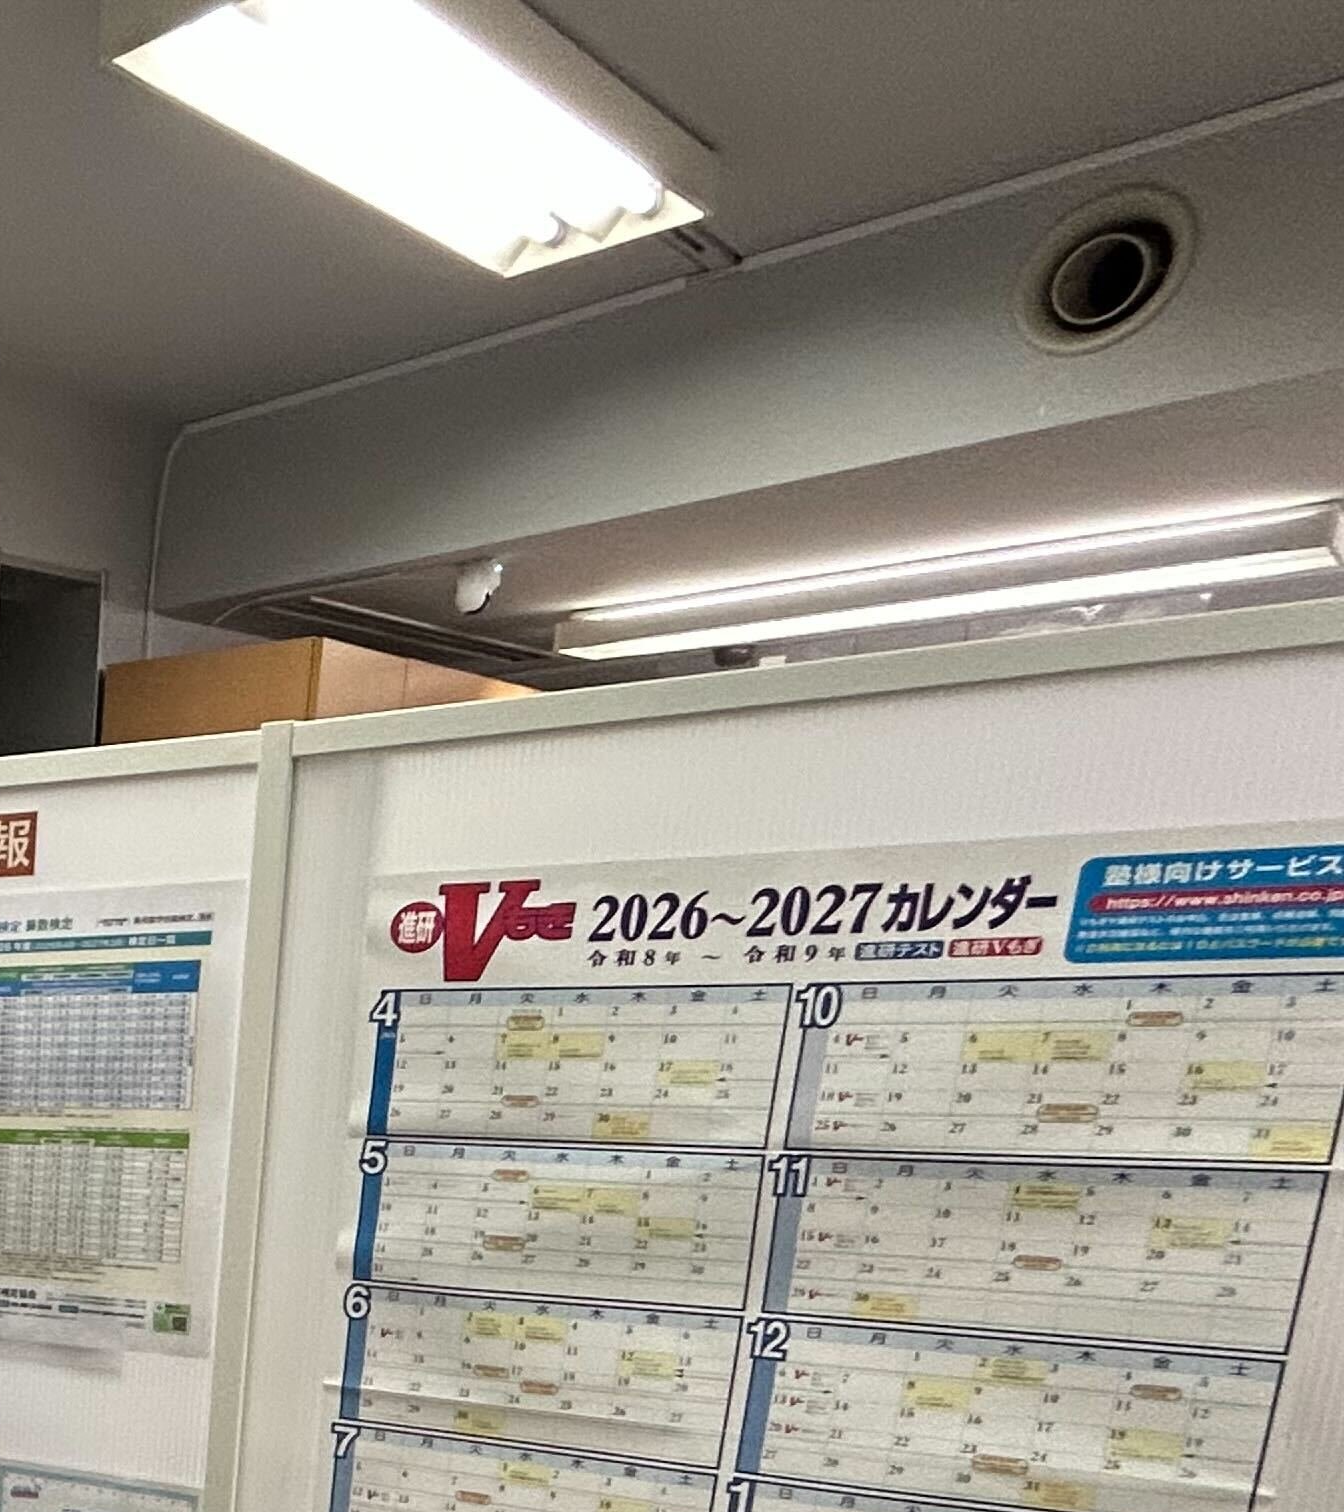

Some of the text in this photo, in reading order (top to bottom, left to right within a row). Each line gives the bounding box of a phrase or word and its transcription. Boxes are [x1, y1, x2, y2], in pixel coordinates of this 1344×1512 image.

[397, 910, 438, 944] 進研
[588, 943, 846, 967] 令和8年 令和9年
[371, 990, 400, 1026] 4
[794, 985, 842, 1028] 10
[360, 1141, 388, 1175] 5
[768, 1158, 811, 1197] 11
[344, 1284, 371, 1319] 6
[748, 1320, 790, 1359] 12
[333, 1425, 359, 1458] 7
